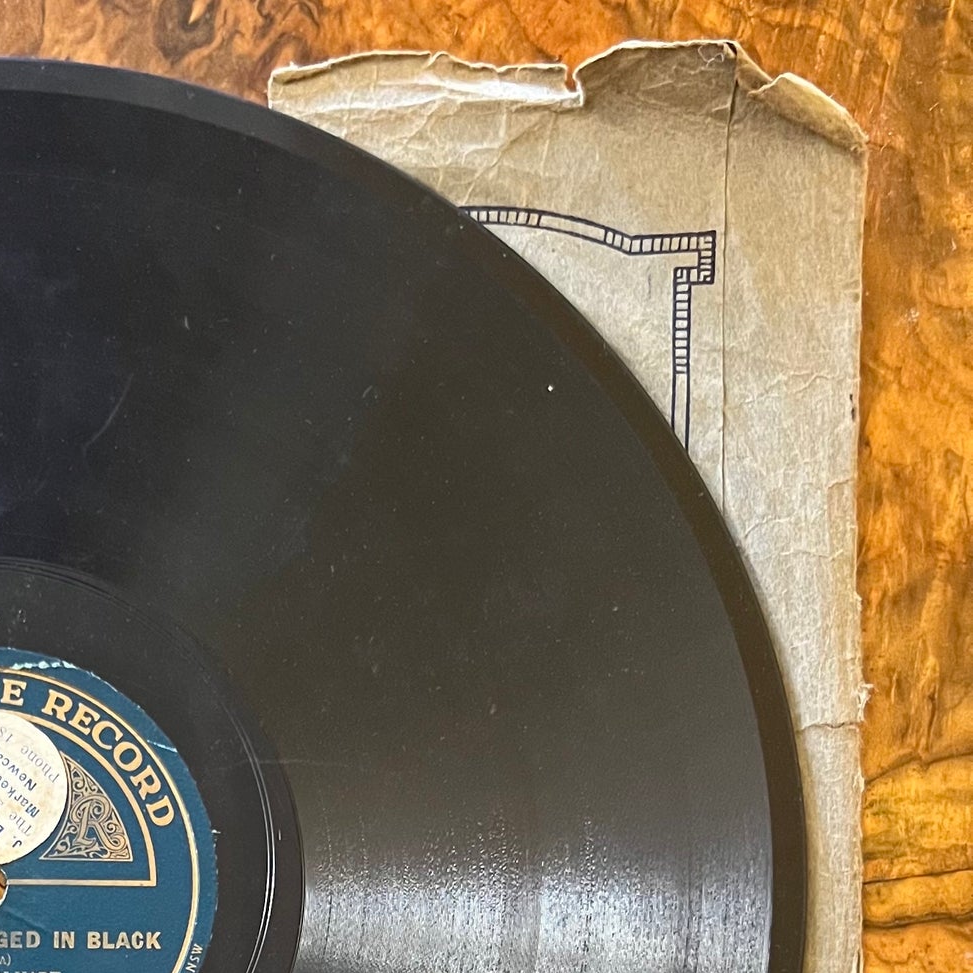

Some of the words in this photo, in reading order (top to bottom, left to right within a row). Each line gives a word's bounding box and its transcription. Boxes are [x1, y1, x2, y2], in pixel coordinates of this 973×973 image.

[21, 744, 60, 784] Phone
[41, 689, 175, 827] RECORD
[9, 811, 33, 837] The
[53, 930, 75, 949] IN
[87, 930, 162, 950] BLACK
